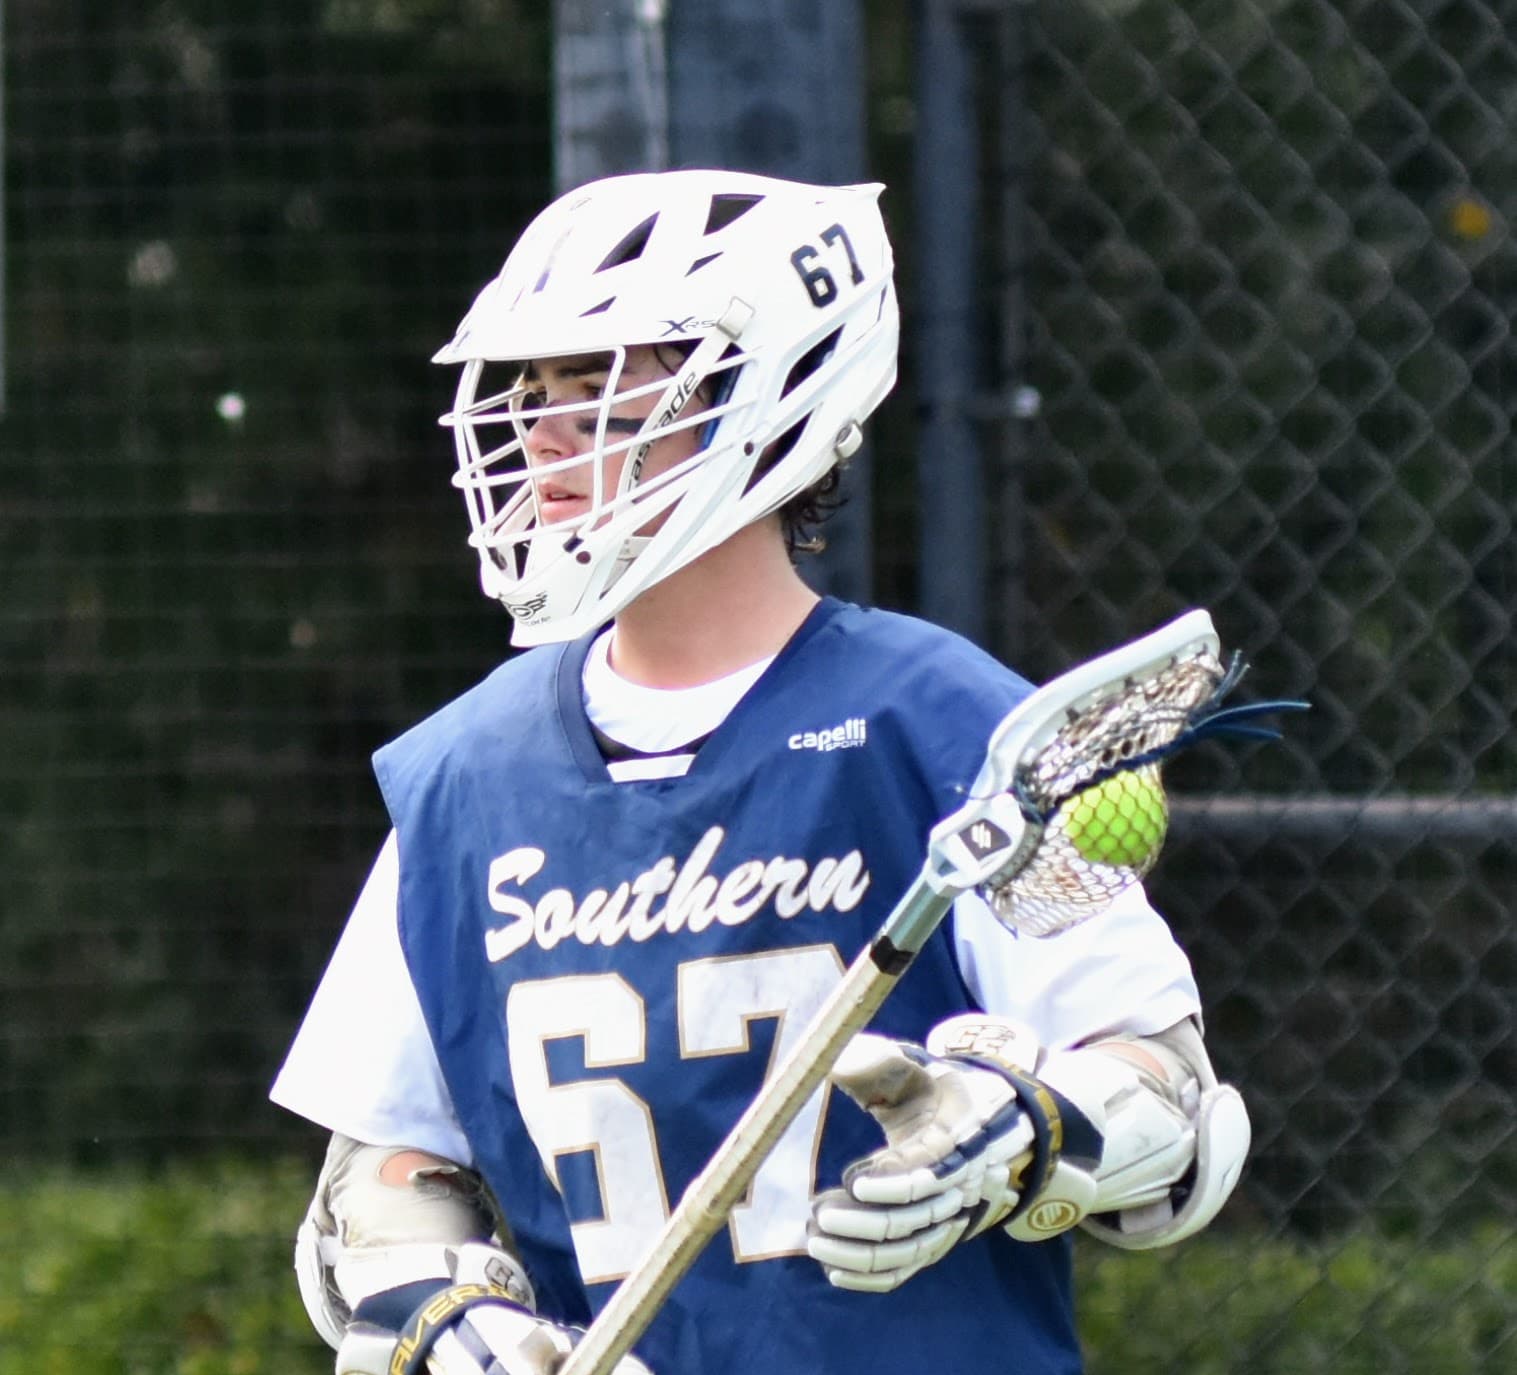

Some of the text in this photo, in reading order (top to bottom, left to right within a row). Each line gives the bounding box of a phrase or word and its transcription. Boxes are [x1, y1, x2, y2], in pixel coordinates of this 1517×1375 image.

[790, 222, 865, 309] 67
[788, 718, 867, 752] capelli
[484, 825, 871, 963] Southern
[506, 943, 848, 1285] 67
